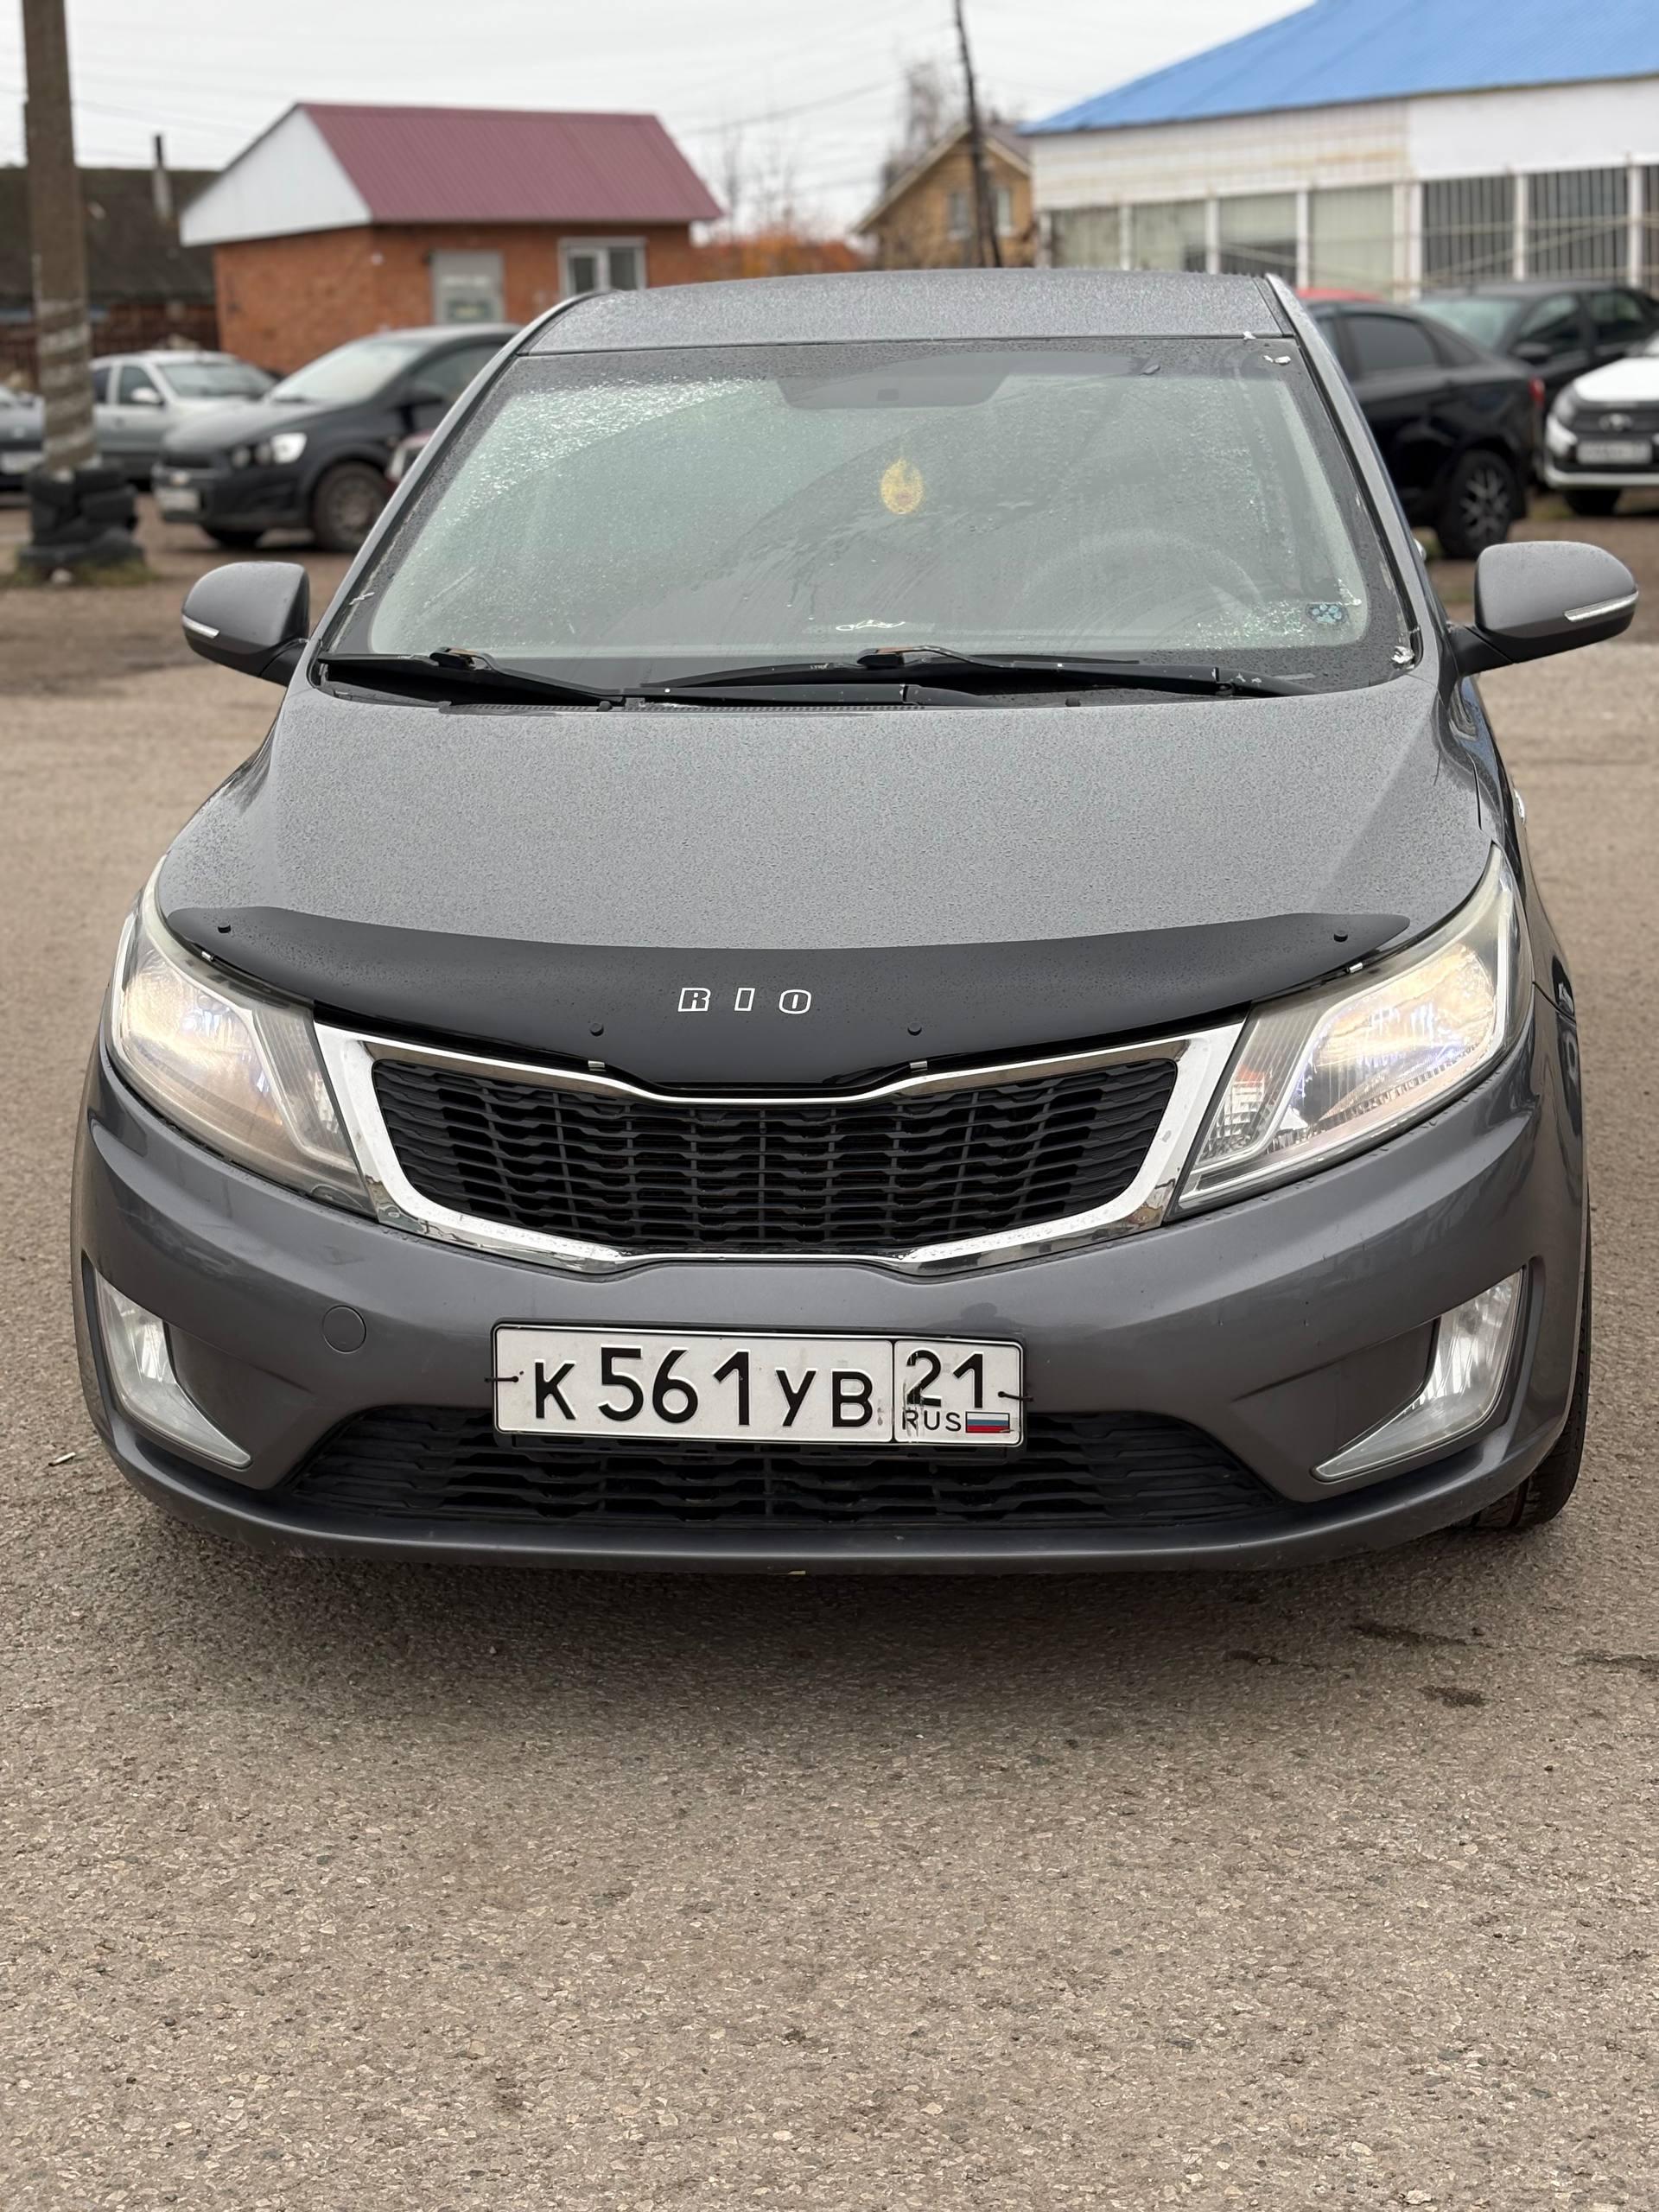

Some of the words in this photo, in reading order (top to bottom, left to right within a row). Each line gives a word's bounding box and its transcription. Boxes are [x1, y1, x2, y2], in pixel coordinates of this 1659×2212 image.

[677, 987, 812, 1014] RIO
[906, 1350, 983, 1408] 21
[902, 1409, 962, 1432] RUS
